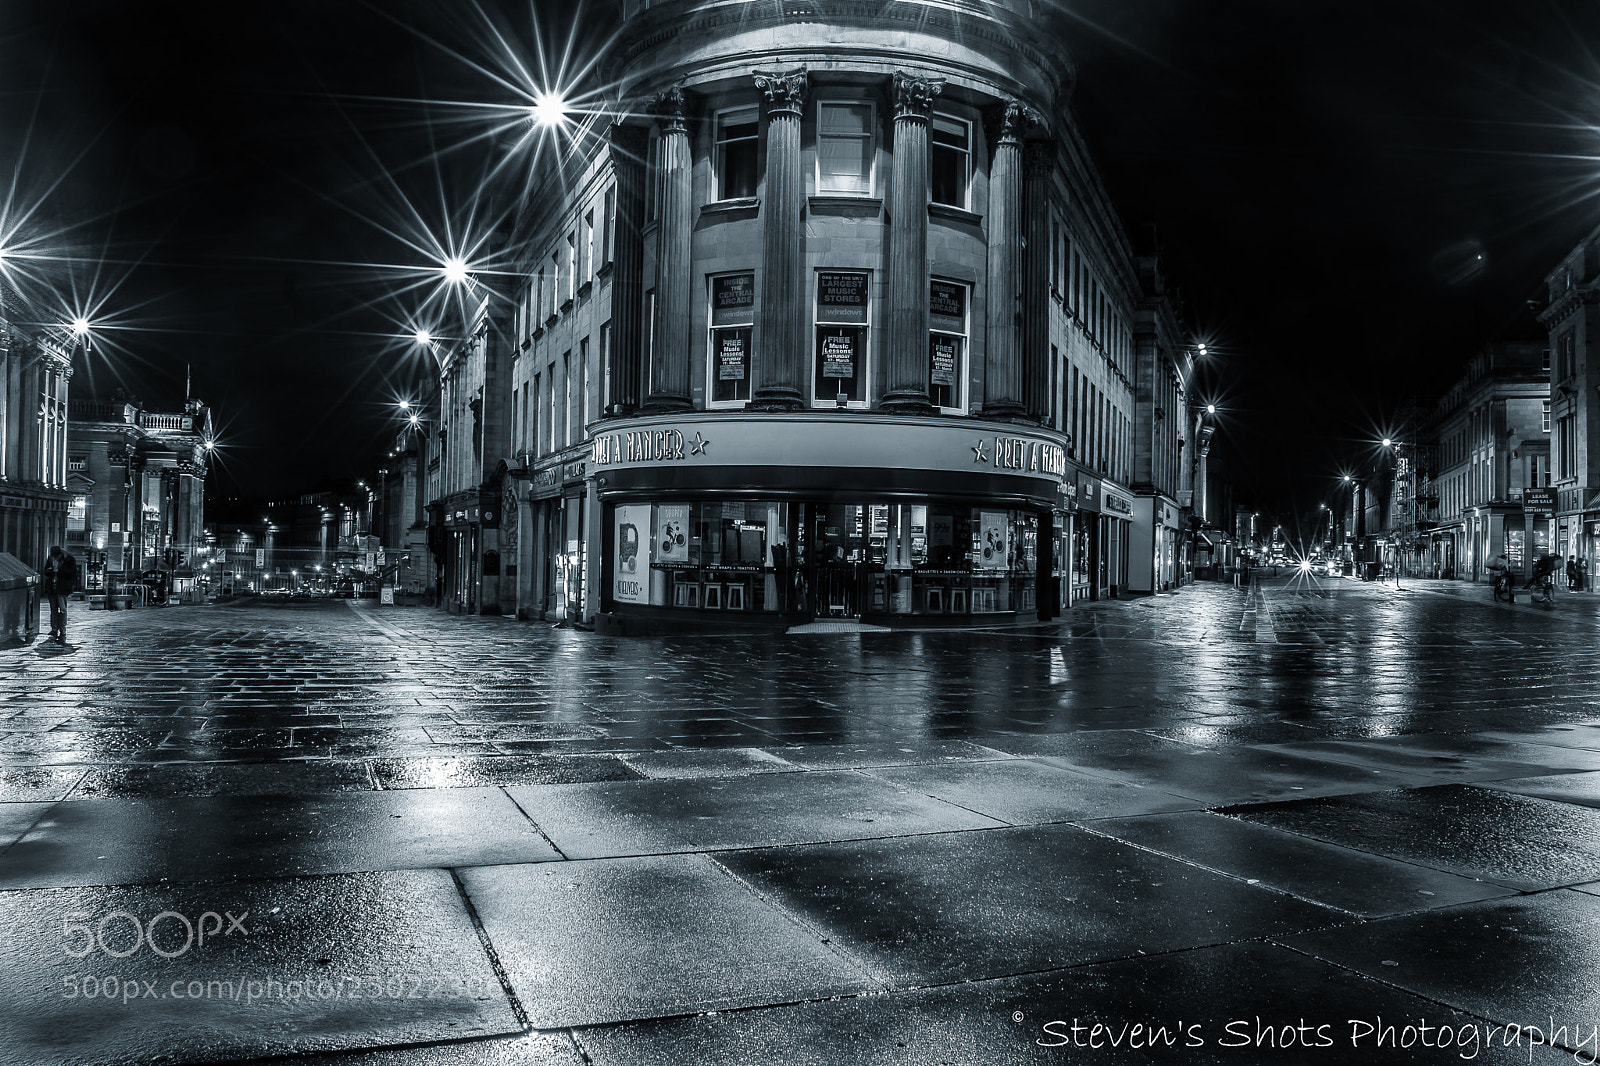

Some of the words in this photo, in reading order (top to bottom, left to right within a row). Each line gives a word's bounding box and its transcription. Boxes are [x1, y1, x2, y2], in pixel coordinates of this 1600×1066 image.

[723, 277, 750, 286] INSIDE
[822, 280, 863, 288] LARGEST
[719, 290, 754, 299] CENTRAL
[827, 287, 857, 295] MUSIC
[720, 297, 752, 306] ARCADE
[824, 294, 860, 303] STORES
[935, 344, 953, 353] FREE
[936, 351, 952, 359] Music
[613, 434, 623, 463] A
[626, 428, 686, 462] MANGER
[994, 436, 1027, 469] PRET
[1029, 441, 1038, 471] A
